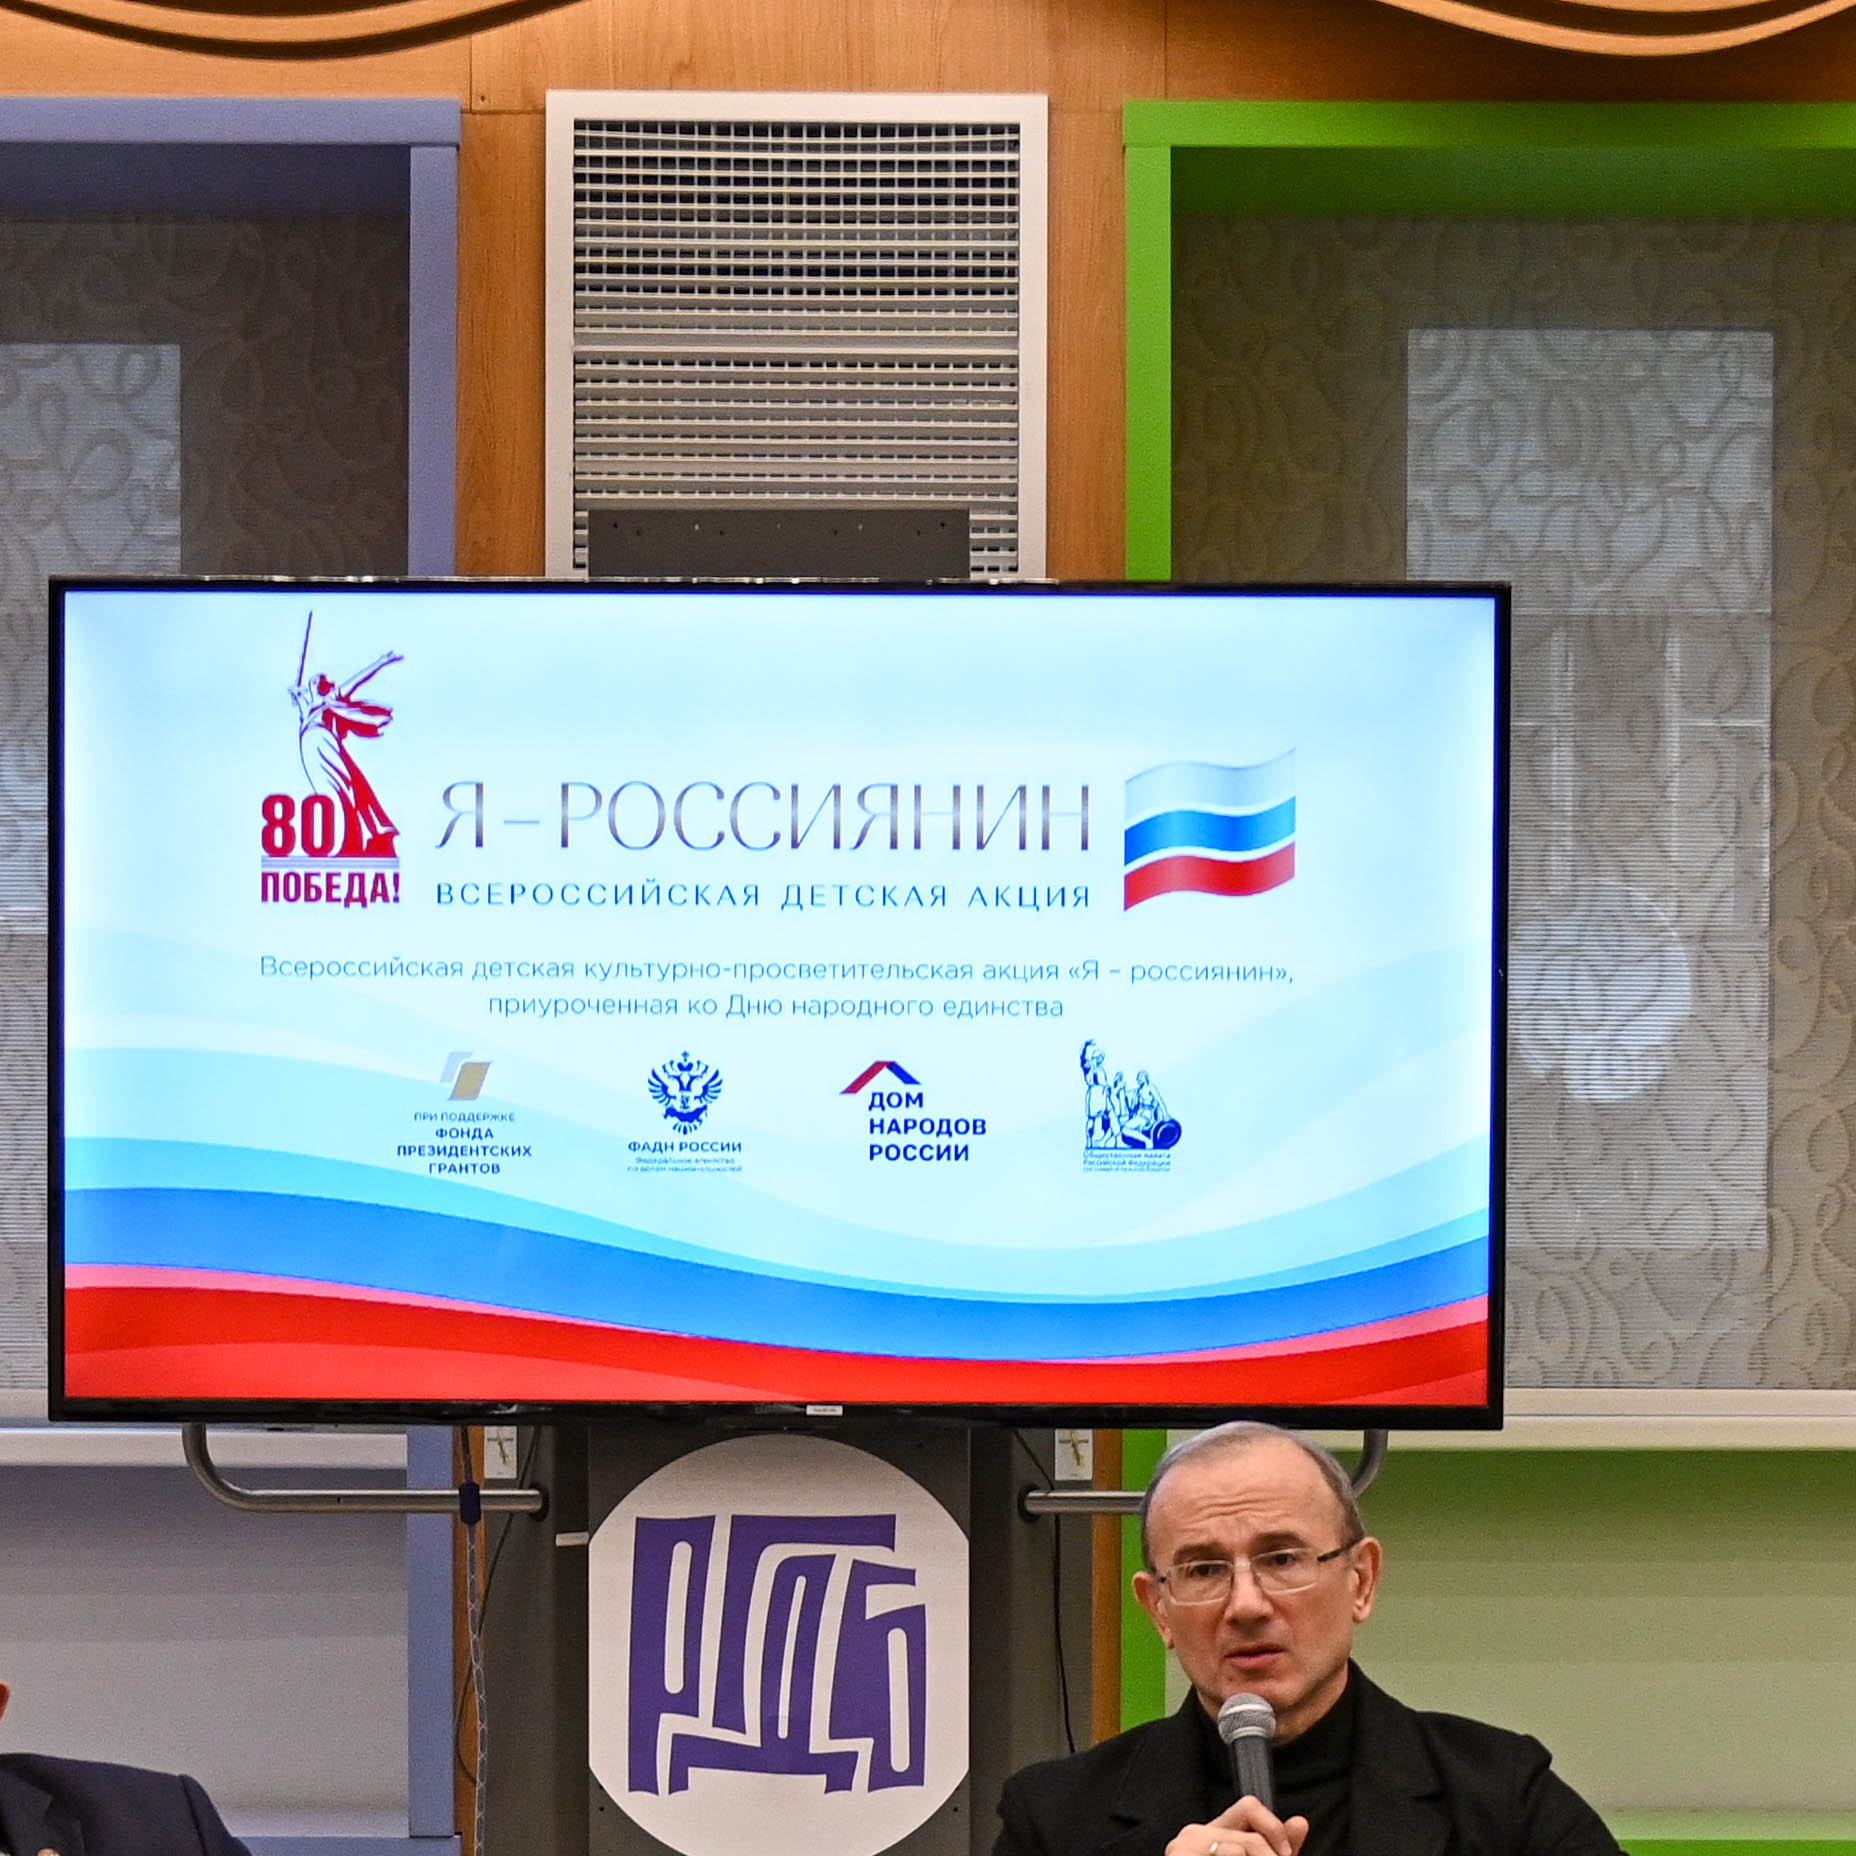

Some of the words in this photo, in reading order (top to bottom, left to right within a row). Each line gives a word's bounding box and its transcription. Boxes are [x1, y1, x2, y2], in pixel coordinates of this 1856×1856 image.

[260, 793, 337, 858] 80
[434, 779, 485, 851] Я
[559, 779, 1090, 853] РОССИЯНИН
[260, 870, 401, 909] ПОБЕДА!
[436, 876, 760, 907] ВСЕРОССИЙСКАЯ
[780, 884, 946, 912] ДЕТСКАЯ
[967, 884, 1090, 913] АКЦИЯ
[259, 954, 464, 982] Всероссийская
[471, 960, 575, 982] детская
[584, 960, 974, 985] культурно-просветительская
[982, 963, 1060, 985] акция
[1068, 959, 1100, 982] «Я
[1130, 963, 1294, 985] россиянин»,
[488, 995, 678, 1019] приуроченная
[687, 998, 718, 1017] ко
[725, 993, 783, 1020] Дню
[791, 998, 934, 1021] народного
[943, 998, 1064, 1021] единства
[867, 1091, 924, 1110] ДОМ
[413, 1111, 438, 1122] ПРИ
[440, 1111, 516, 1123] ПОДДЕРЖКЕ
[868, 1116, 988, 1138] НАРОДОВ
[435, 1127, 495, 1141] ФОНДА
[396, 1144, 533, 1158] ПРЕЗИДЕНТСКИХ
[627, 1140, 675, 1155] ФАДН
[678, 1140, 742, 1153] РОССИИ
[868, 1143, 970, 1163] РОССИИ
[428, 1161, 501, 1175] ГРАНТОВ
